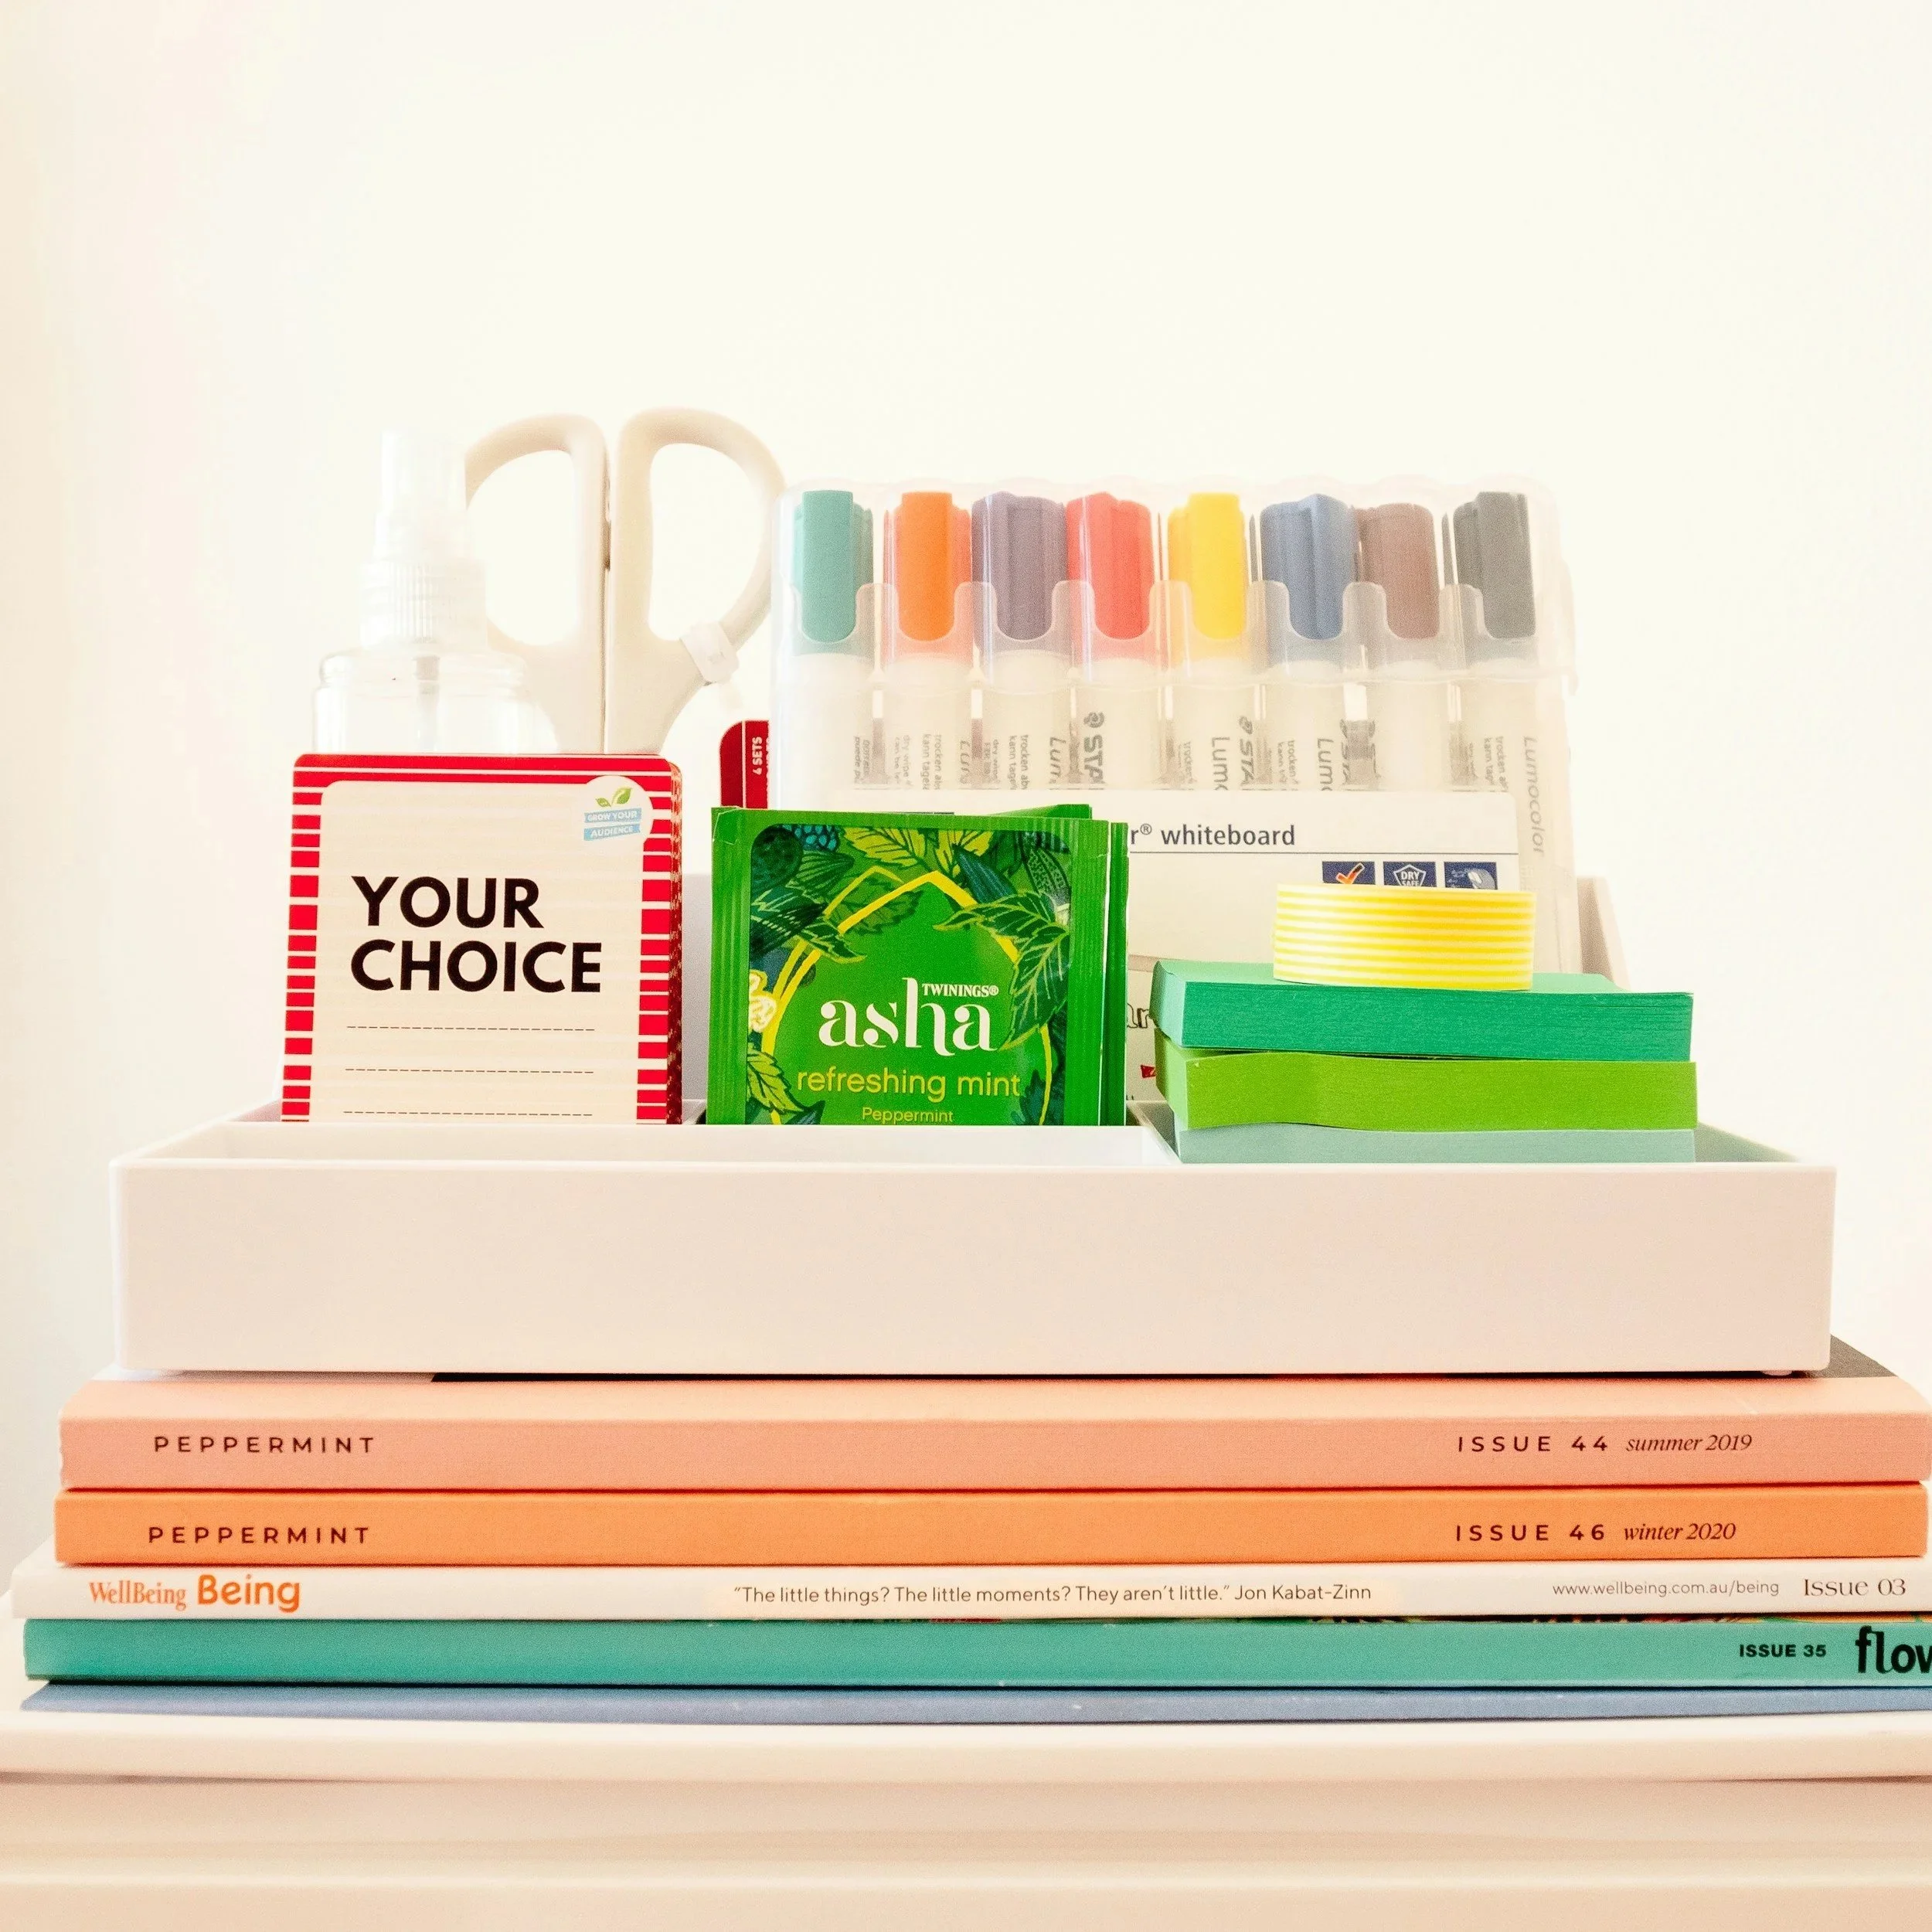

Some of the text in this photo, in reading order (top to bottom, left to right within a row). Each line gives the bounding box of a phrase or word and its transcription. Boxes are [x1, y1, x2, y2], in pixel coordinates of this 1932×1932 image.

[752, 736, 763, 766] SETS
[1523, 736, 1545, 857] Lumocolor
[587, 810, 638, 821] GROW YOUR
[590, 825, 634, 838] AUDIENCE
[1161, 824, 1294, 845] whiteboard
[1400, 871, 1420, 880] DRY
[351, 876, 544, 928] YOUR
[350, 939, 602, 993] CHOICE
[818, 977, 998, 1056] asha
[798, 1066, 1021, 1103] refreshing mint
[862, 1107, 953, 1124] Peppermint
[154, 1436, 374, 1454] PEPPERMINT
[1458, 1434, 1752, 1452] ISSUE 44 summer 2019
[149, 1526, 369, 1544] PEPPERMINT
[1456, 1523, 1736, 1541] ISSUE 46 winter 2020
[89, 1574, 300, 1613] WellBeing Being
[780, 1587, 819, 1603] little
[825, 1587, 889, 1607] things?
[895, 1587, 927, 1602] The
[933, 1587, 971, 1602] little
[977, 1586, 1070, 1602] moments?
[1076, 1586, 1118, 1605] They
[1124, 1586, 1174, 1601] aren't
[1234, 1585, 1266, 1600] Jon
[1273, 1584, 1371, 1600] Kabat-Zinn
[1553, 1579, 1906, 1597] www.wellbeing.com.au/being Issue 03
[1740, 1644, 1796, 1658] ISSUE
[1804, 1644, 1827, 1658] 35
